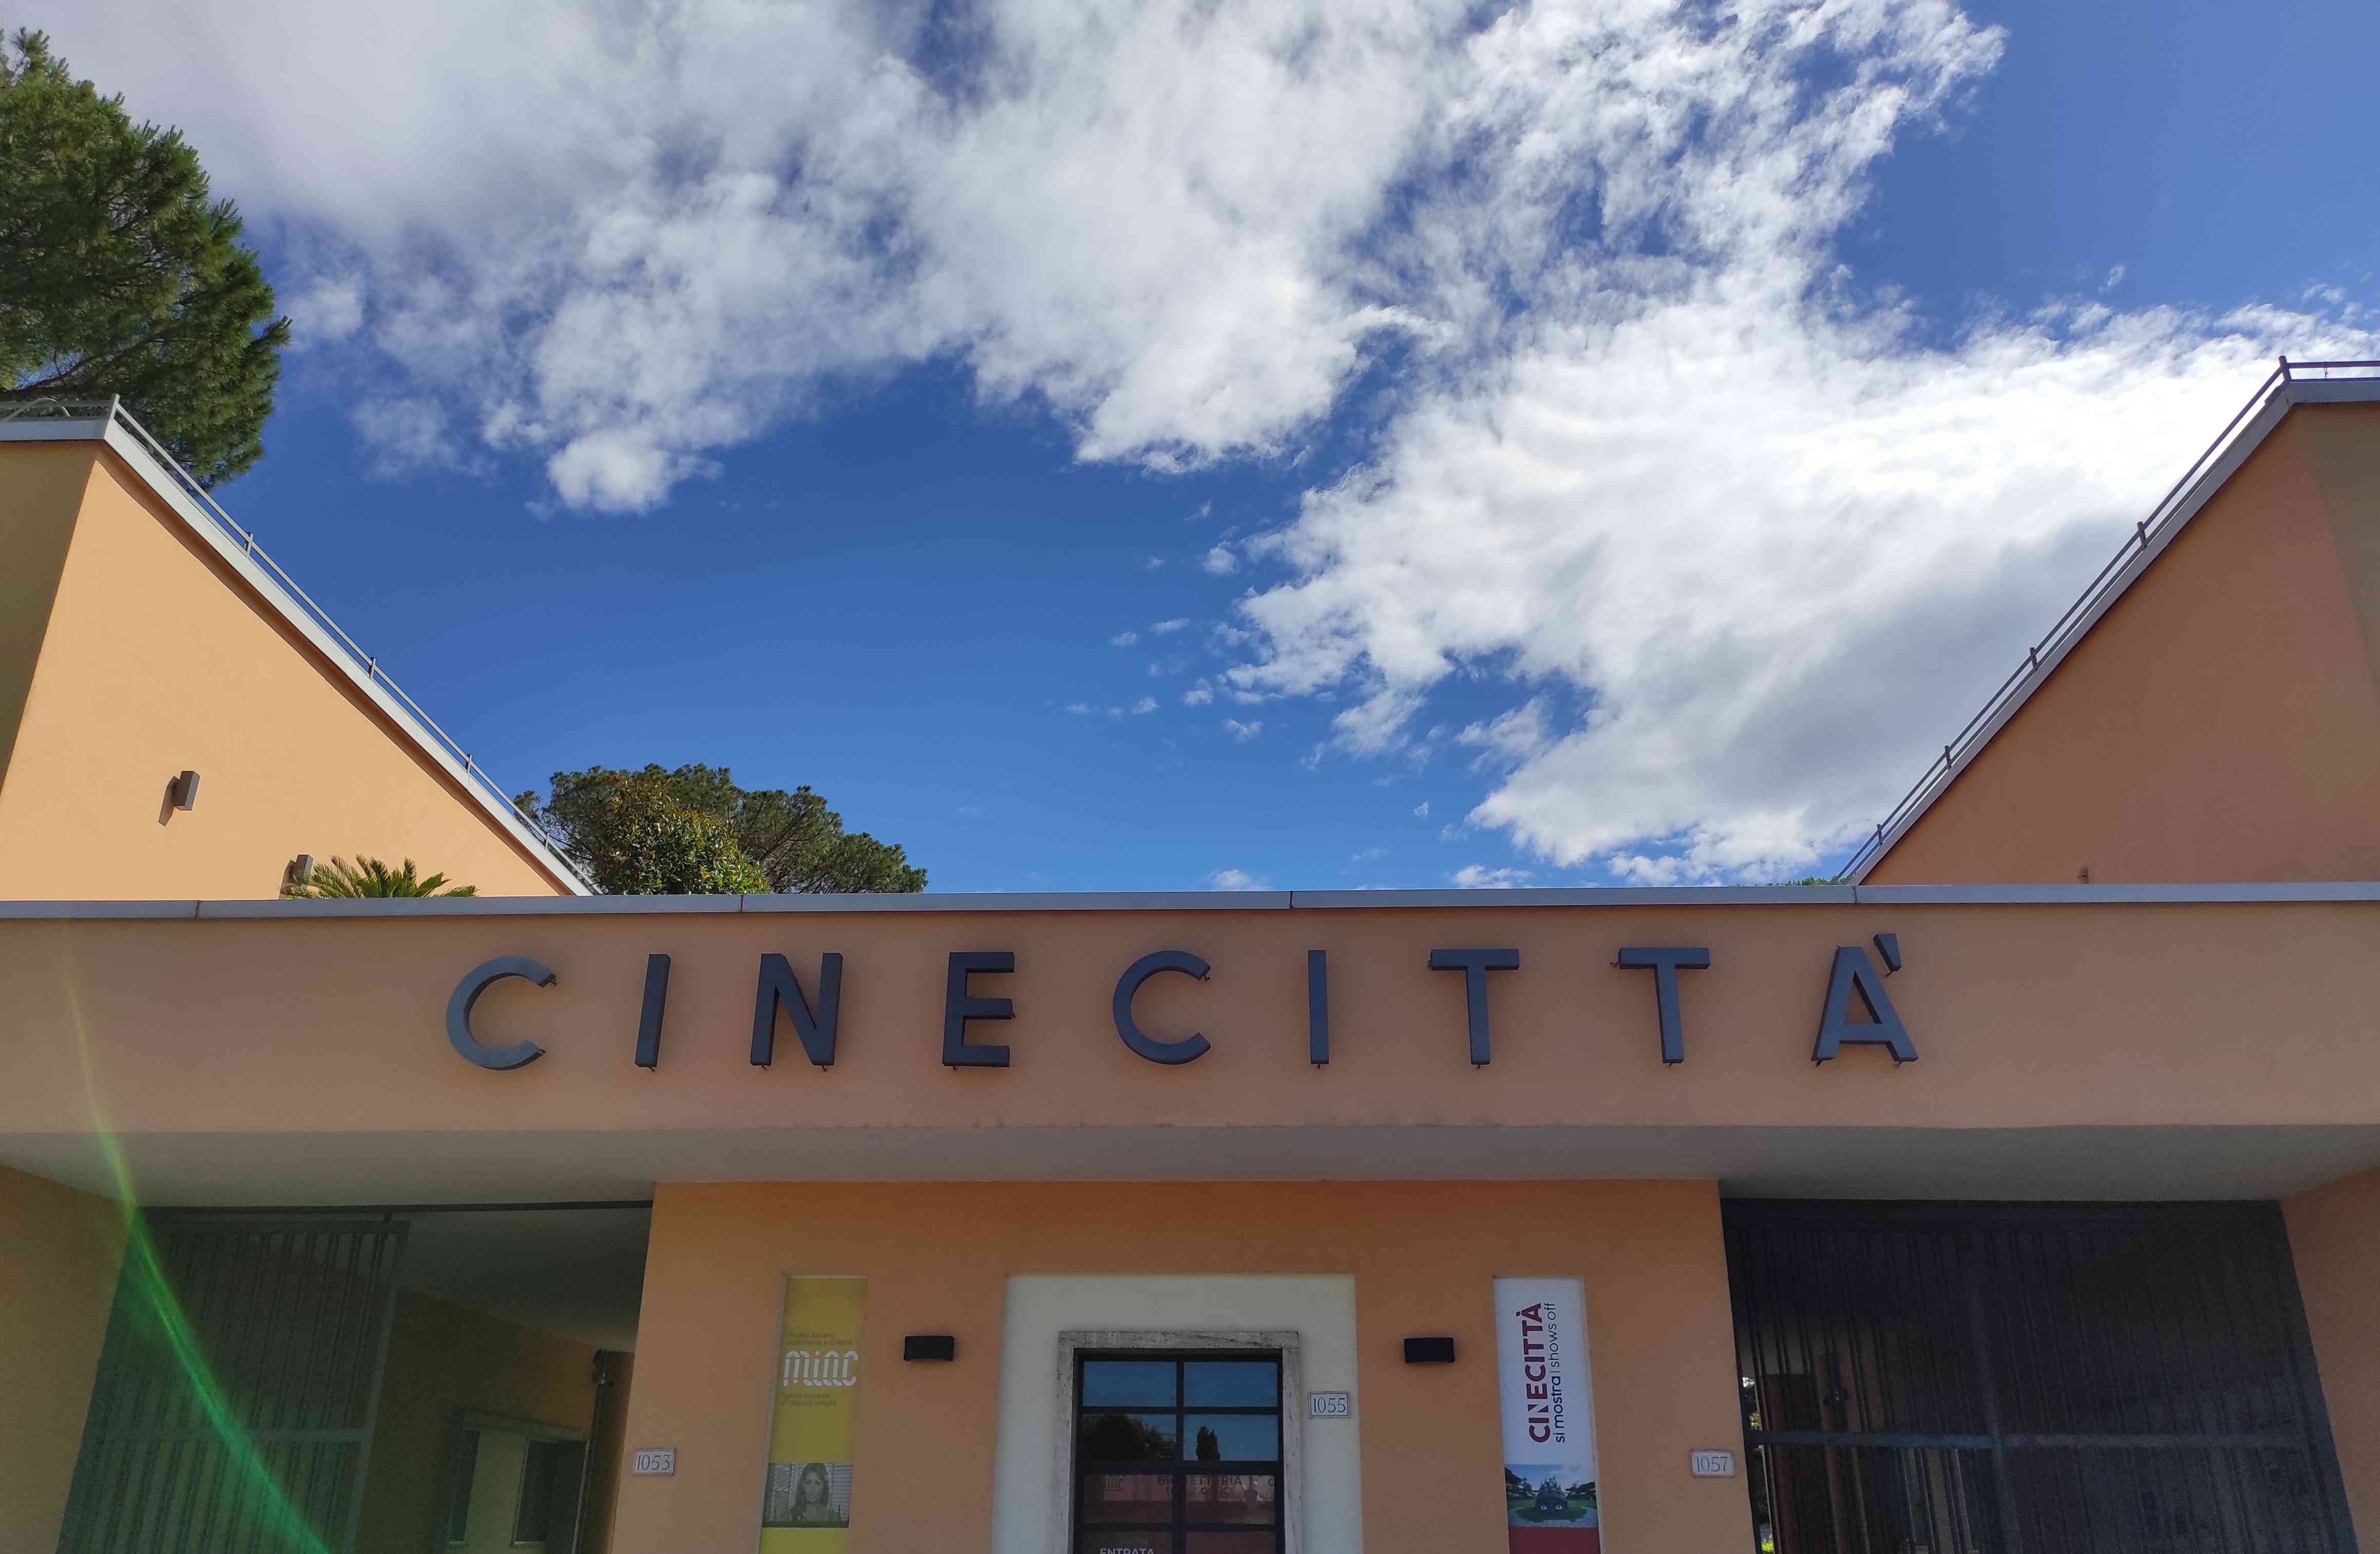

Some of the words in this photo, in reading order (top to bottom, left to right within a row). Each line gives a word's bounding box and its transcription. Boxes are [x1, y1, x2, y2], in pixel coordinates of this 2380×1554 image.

[446, 932, 1919, 1071] CINECITTÀ
[1544, 1302, 1556, 1320] off
[1548, 1323, 1560, 1368] shows
[1516, 1302, 1551, 1443] CINECITTÀ
[1314, 1397, 1346, 1413] 1055
[1551, 1376, 1564, 1428] mostra
[1553, 1432, 1565, 1443] si
[637, 1454, 670, 1470] 1053
[1697, 1455, 1729, 1472] 1057
